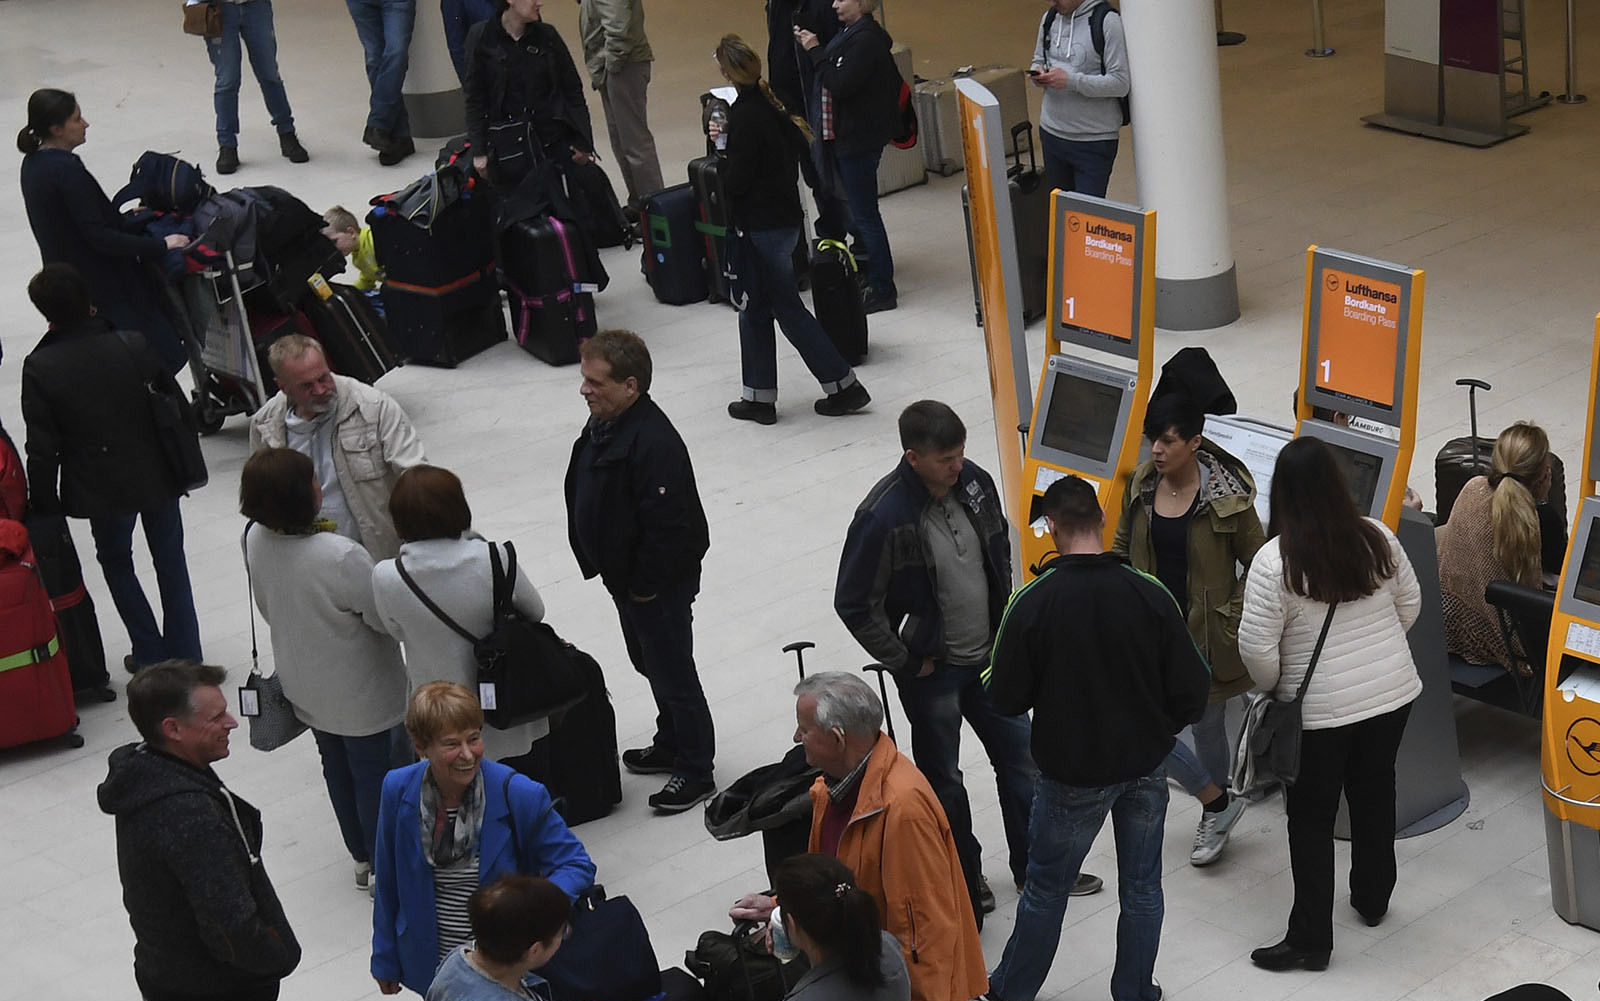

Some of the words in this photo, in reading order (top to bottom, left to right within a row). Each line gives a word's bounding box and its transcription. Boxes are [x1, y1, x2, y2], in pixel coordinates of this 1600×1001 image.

[973, 114, 988, 169] 1
[1085, 221, 1132, 243] Lufthansa
[1084, 235, 1123, 253] Bordkarte
[1084, 246, 1114, 264] Boarding
[1115, 254, 1132, 267] Pass
[1345, 280, 1397, 304] Lufthansa
[1065, 296, 1075, 319] 1
[1344, 295, 1387, 314] Bordkarte
[1343, 307, 1377, 326] Boarding
[1377, 316, 1396, 329] Pass
[1320, 359, 1331, 383] 1
